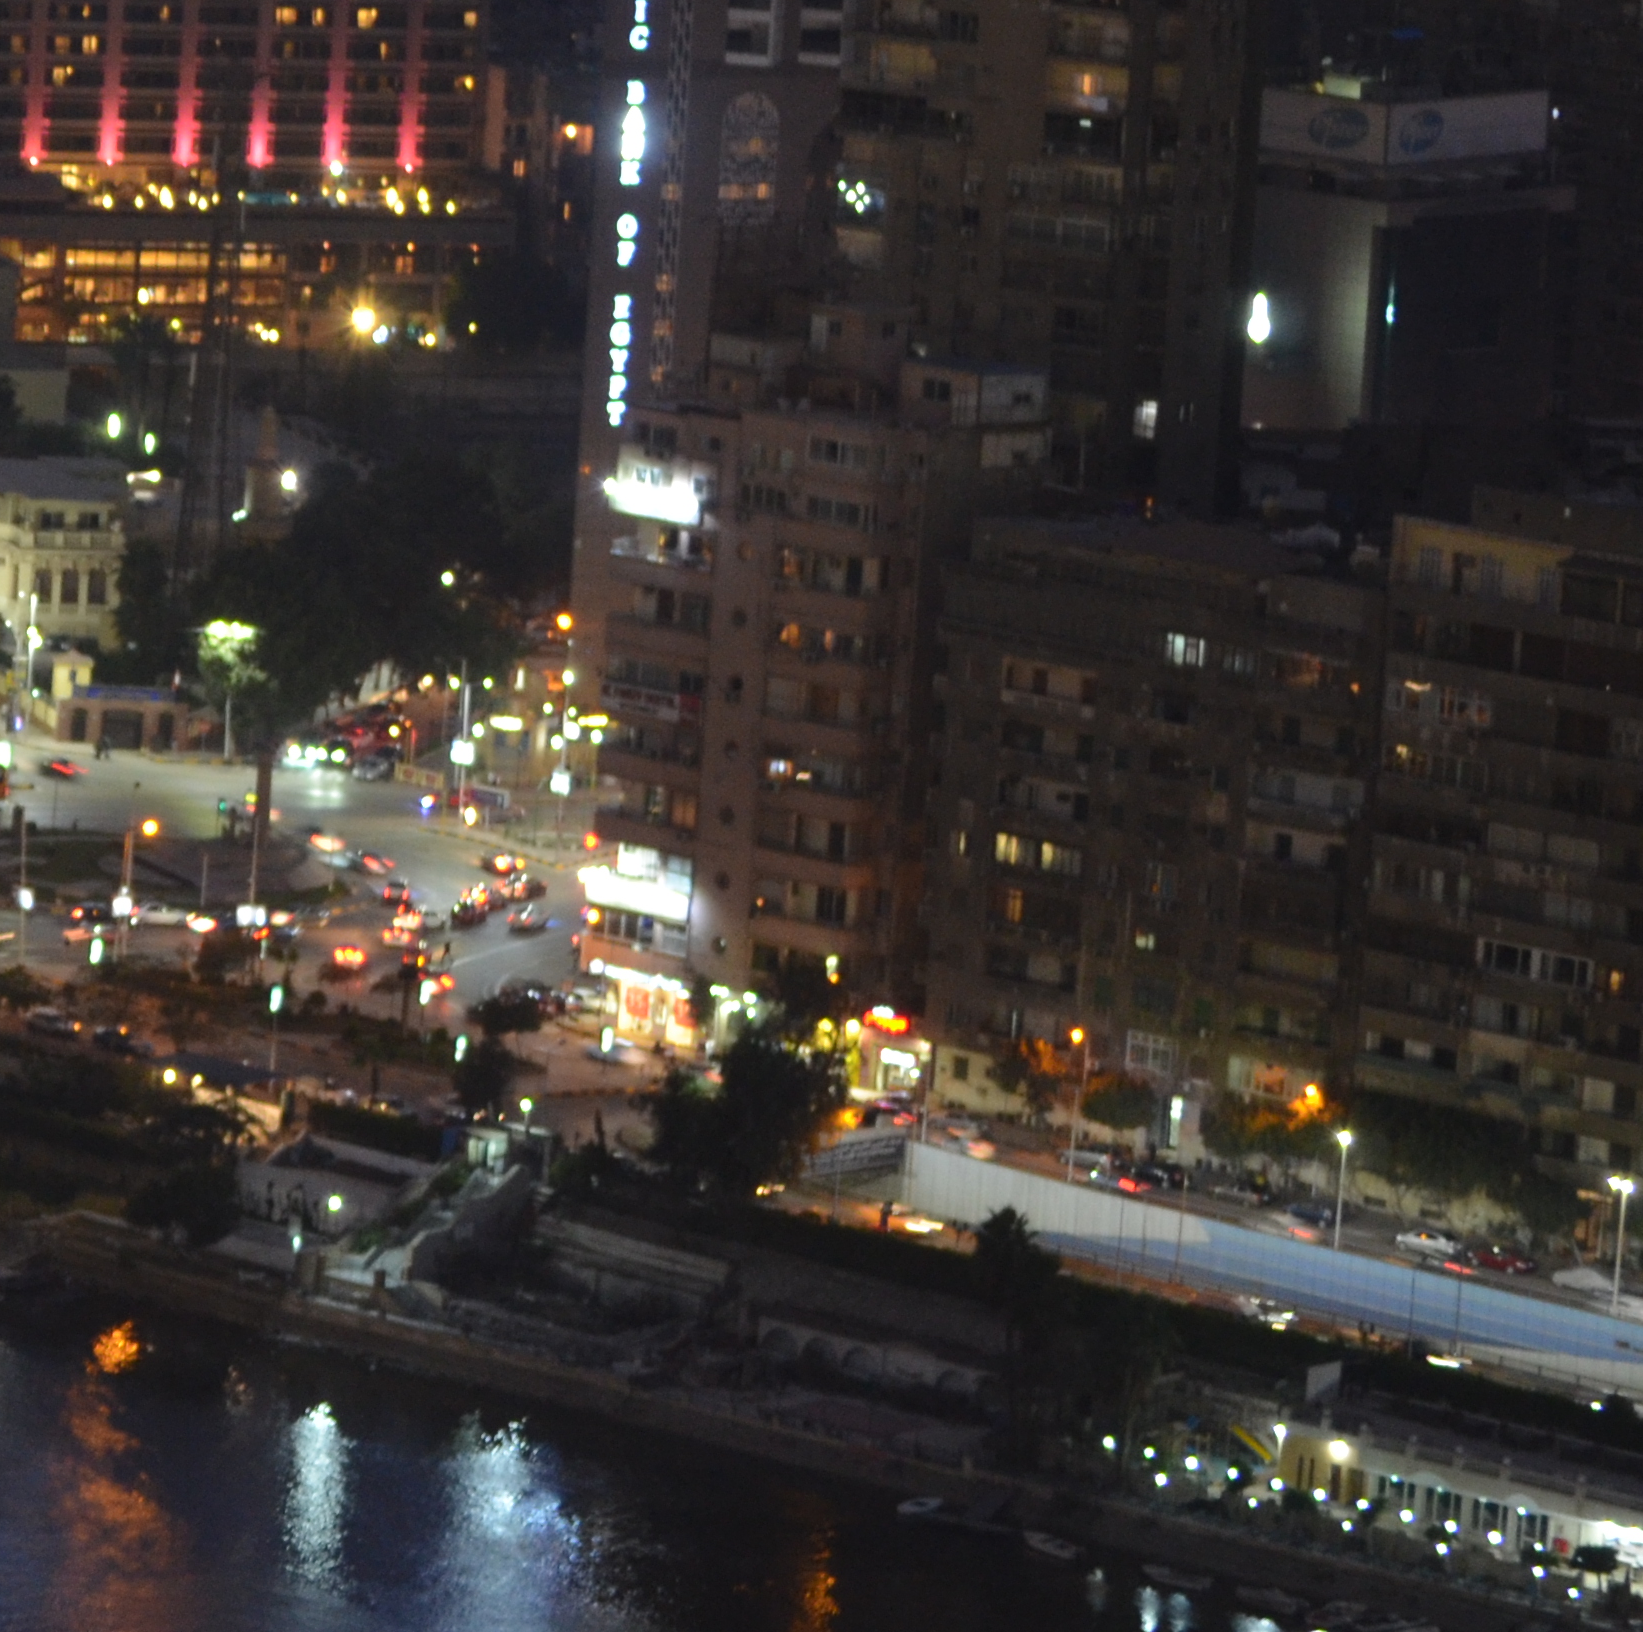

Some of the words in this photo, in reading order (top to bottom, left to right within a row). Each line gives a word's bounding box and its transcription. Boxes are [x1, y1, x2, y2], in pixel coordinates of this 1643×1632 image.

[618, 80, 647, 186] BANK
[616, 213, 641, 267] OF
[605, 294, 634, 426] EGYPT
